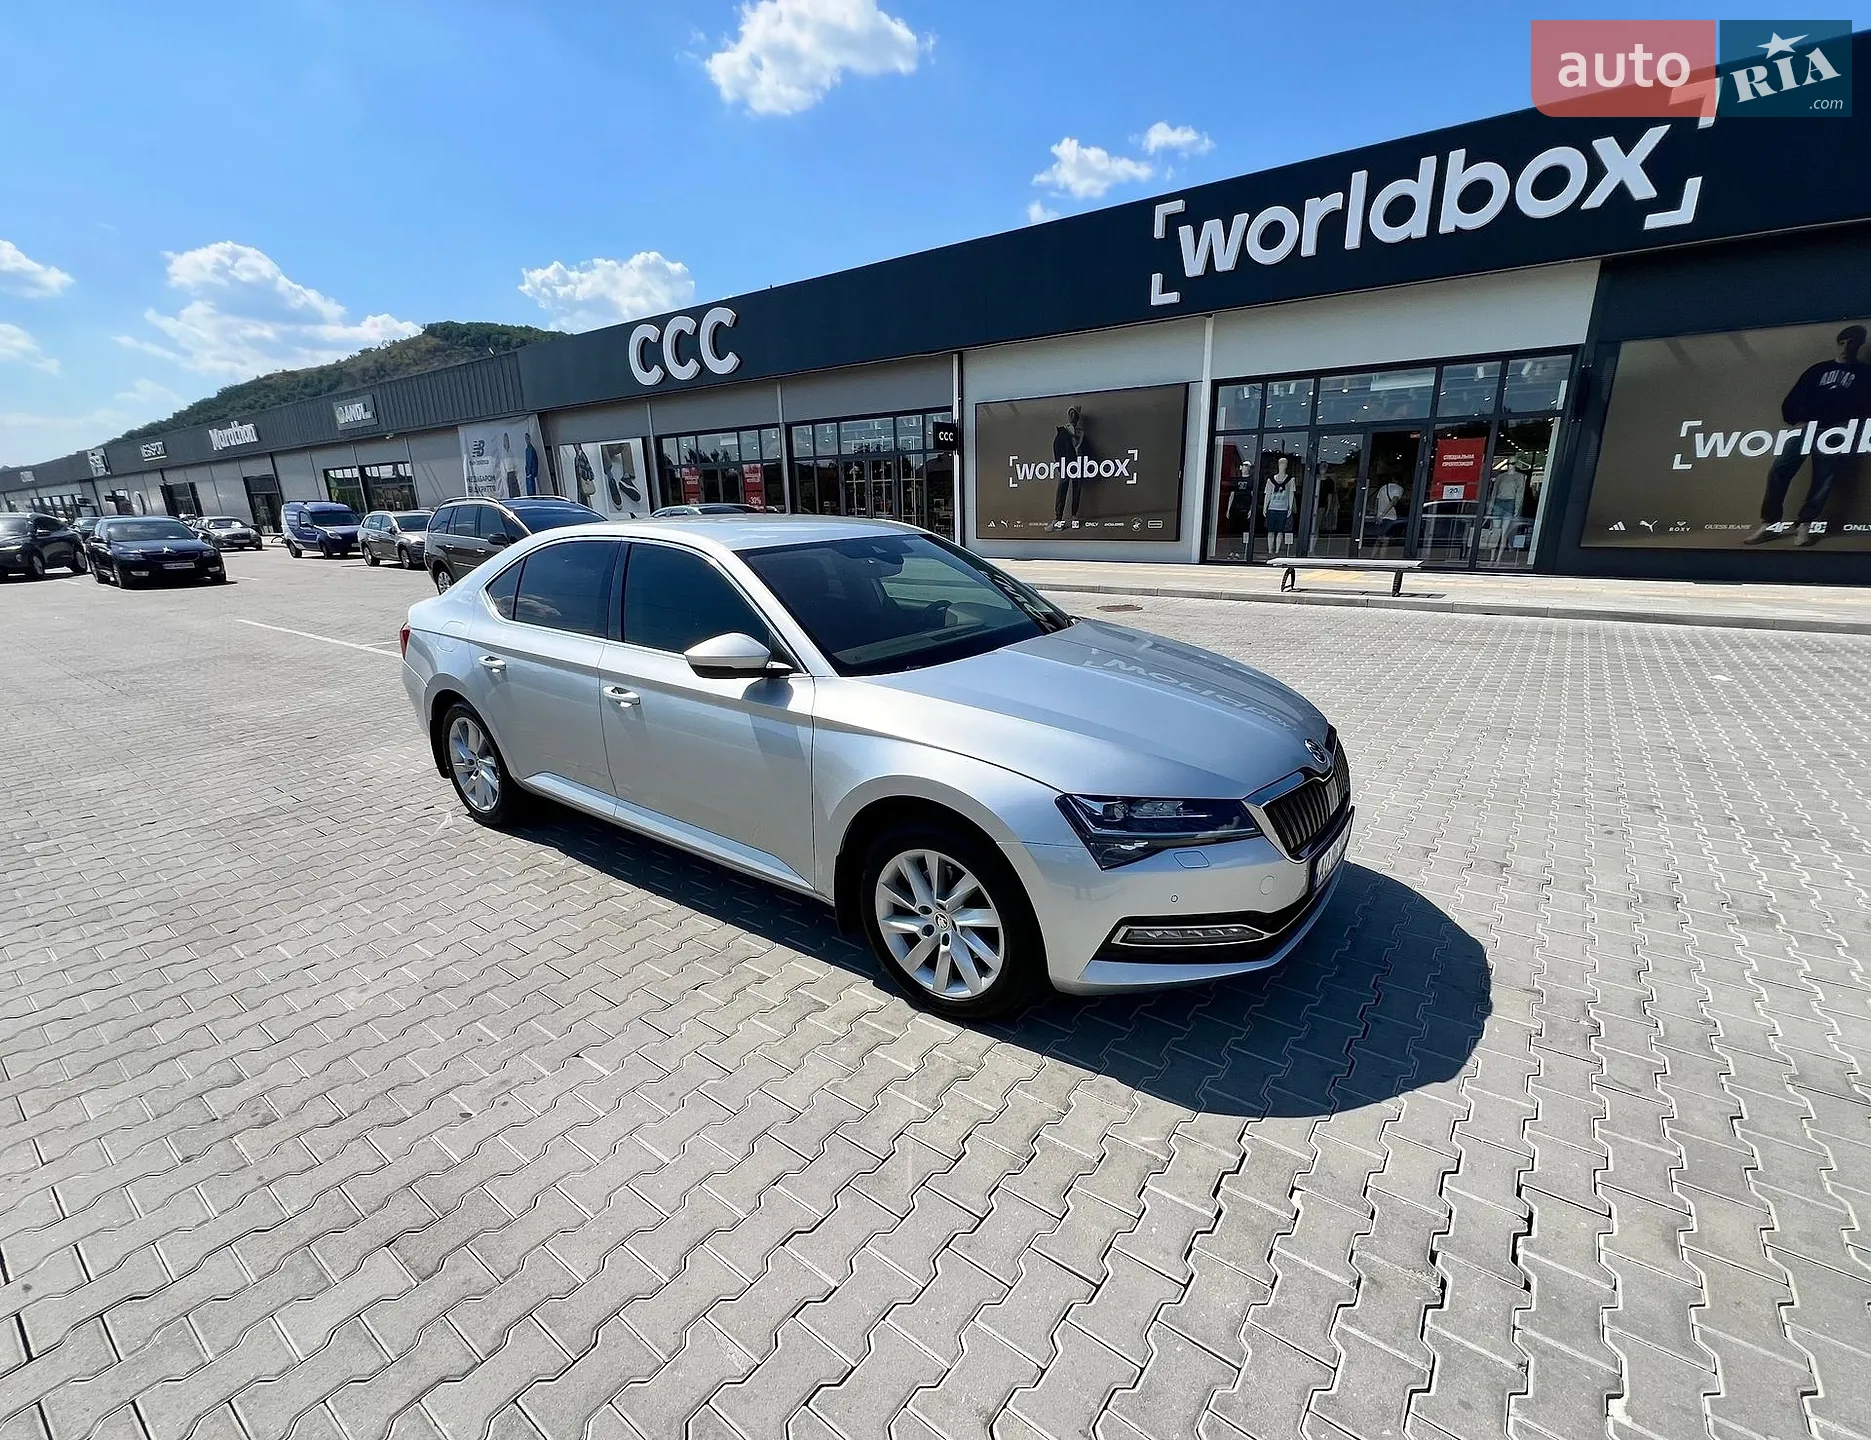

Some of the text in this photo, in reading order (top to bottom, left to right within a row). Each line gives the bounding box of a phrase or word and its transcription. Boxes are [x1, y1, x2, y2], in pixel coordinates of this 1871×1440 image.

[1178, 124, 1672, 277] worldbox
[628, 307, 740, 386] CCC
[209, 420, 259, 450] Marathon
[939, 431, 953, 441] CCC
[1015, 455, 1130, 480] worldbox
